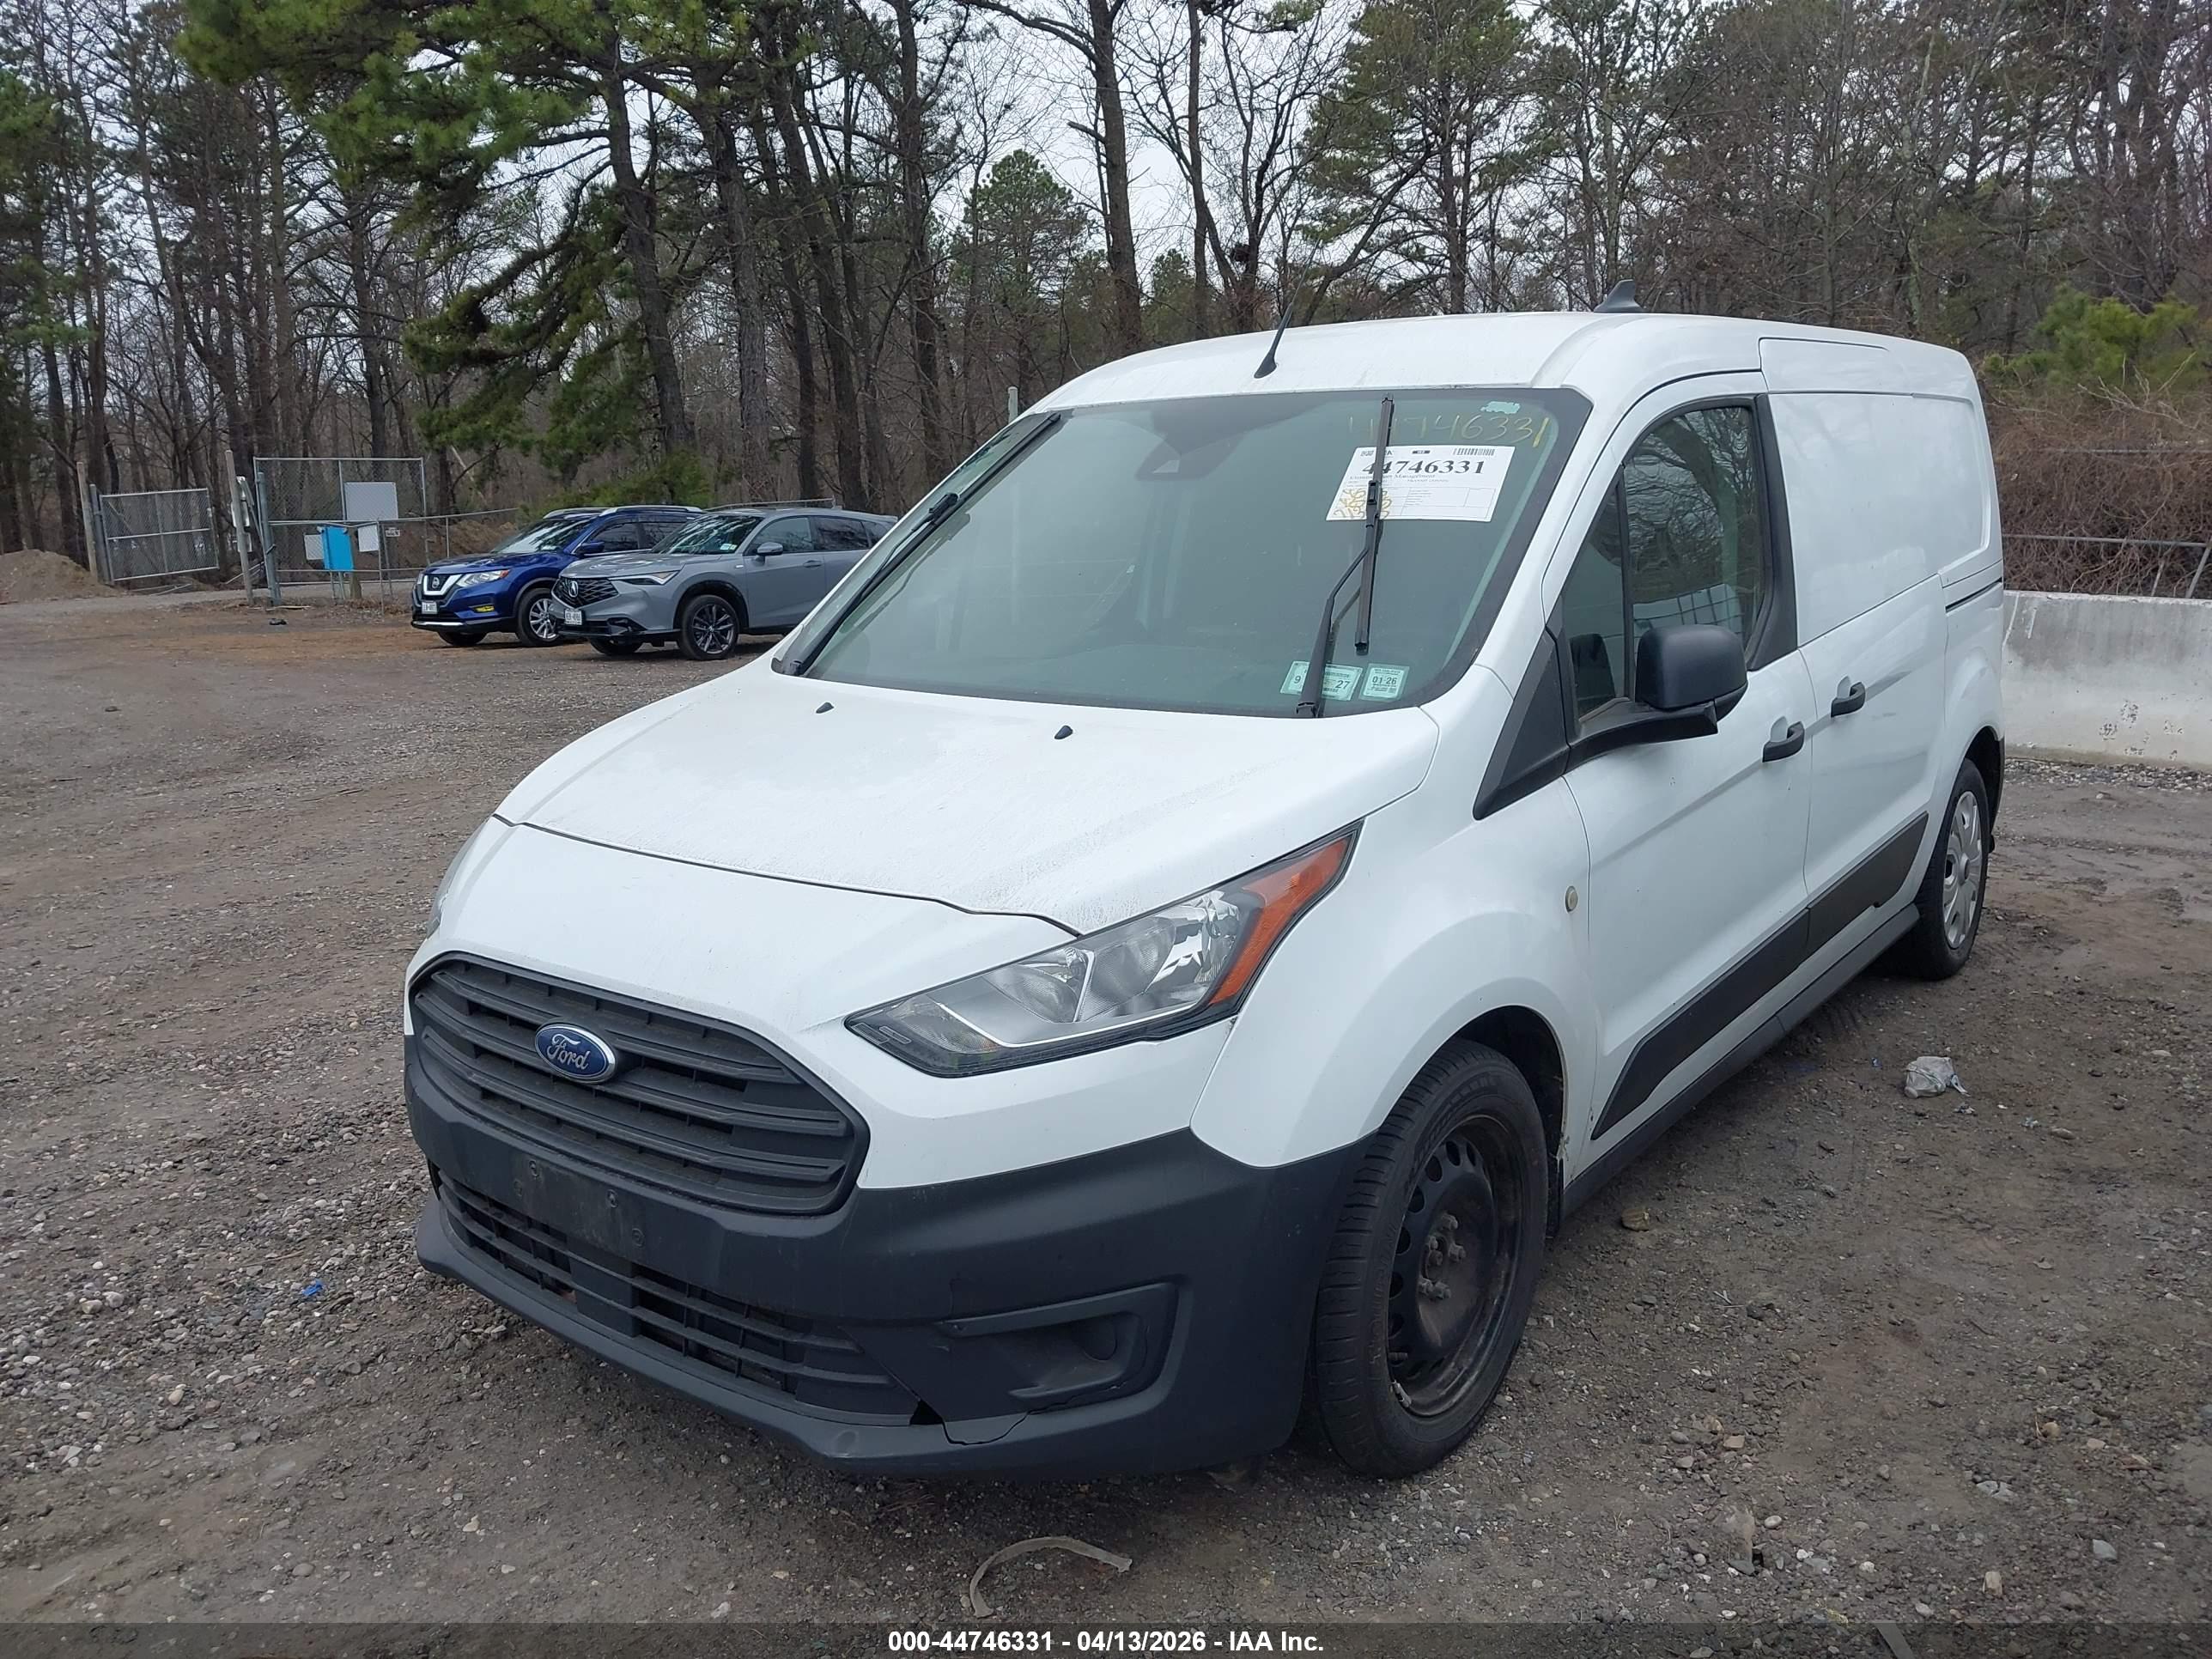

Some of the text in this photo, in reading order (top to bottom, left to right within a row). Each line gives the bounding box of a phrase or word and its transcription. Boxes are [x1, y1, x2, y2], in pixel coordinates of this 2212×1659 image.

[1362, 459, 1486, 474] 44746331
[1294, 675, 1302, 684] 9
[1334, 679, 1350, 690] 27
[547, 1033, 591, 1070] Ford
